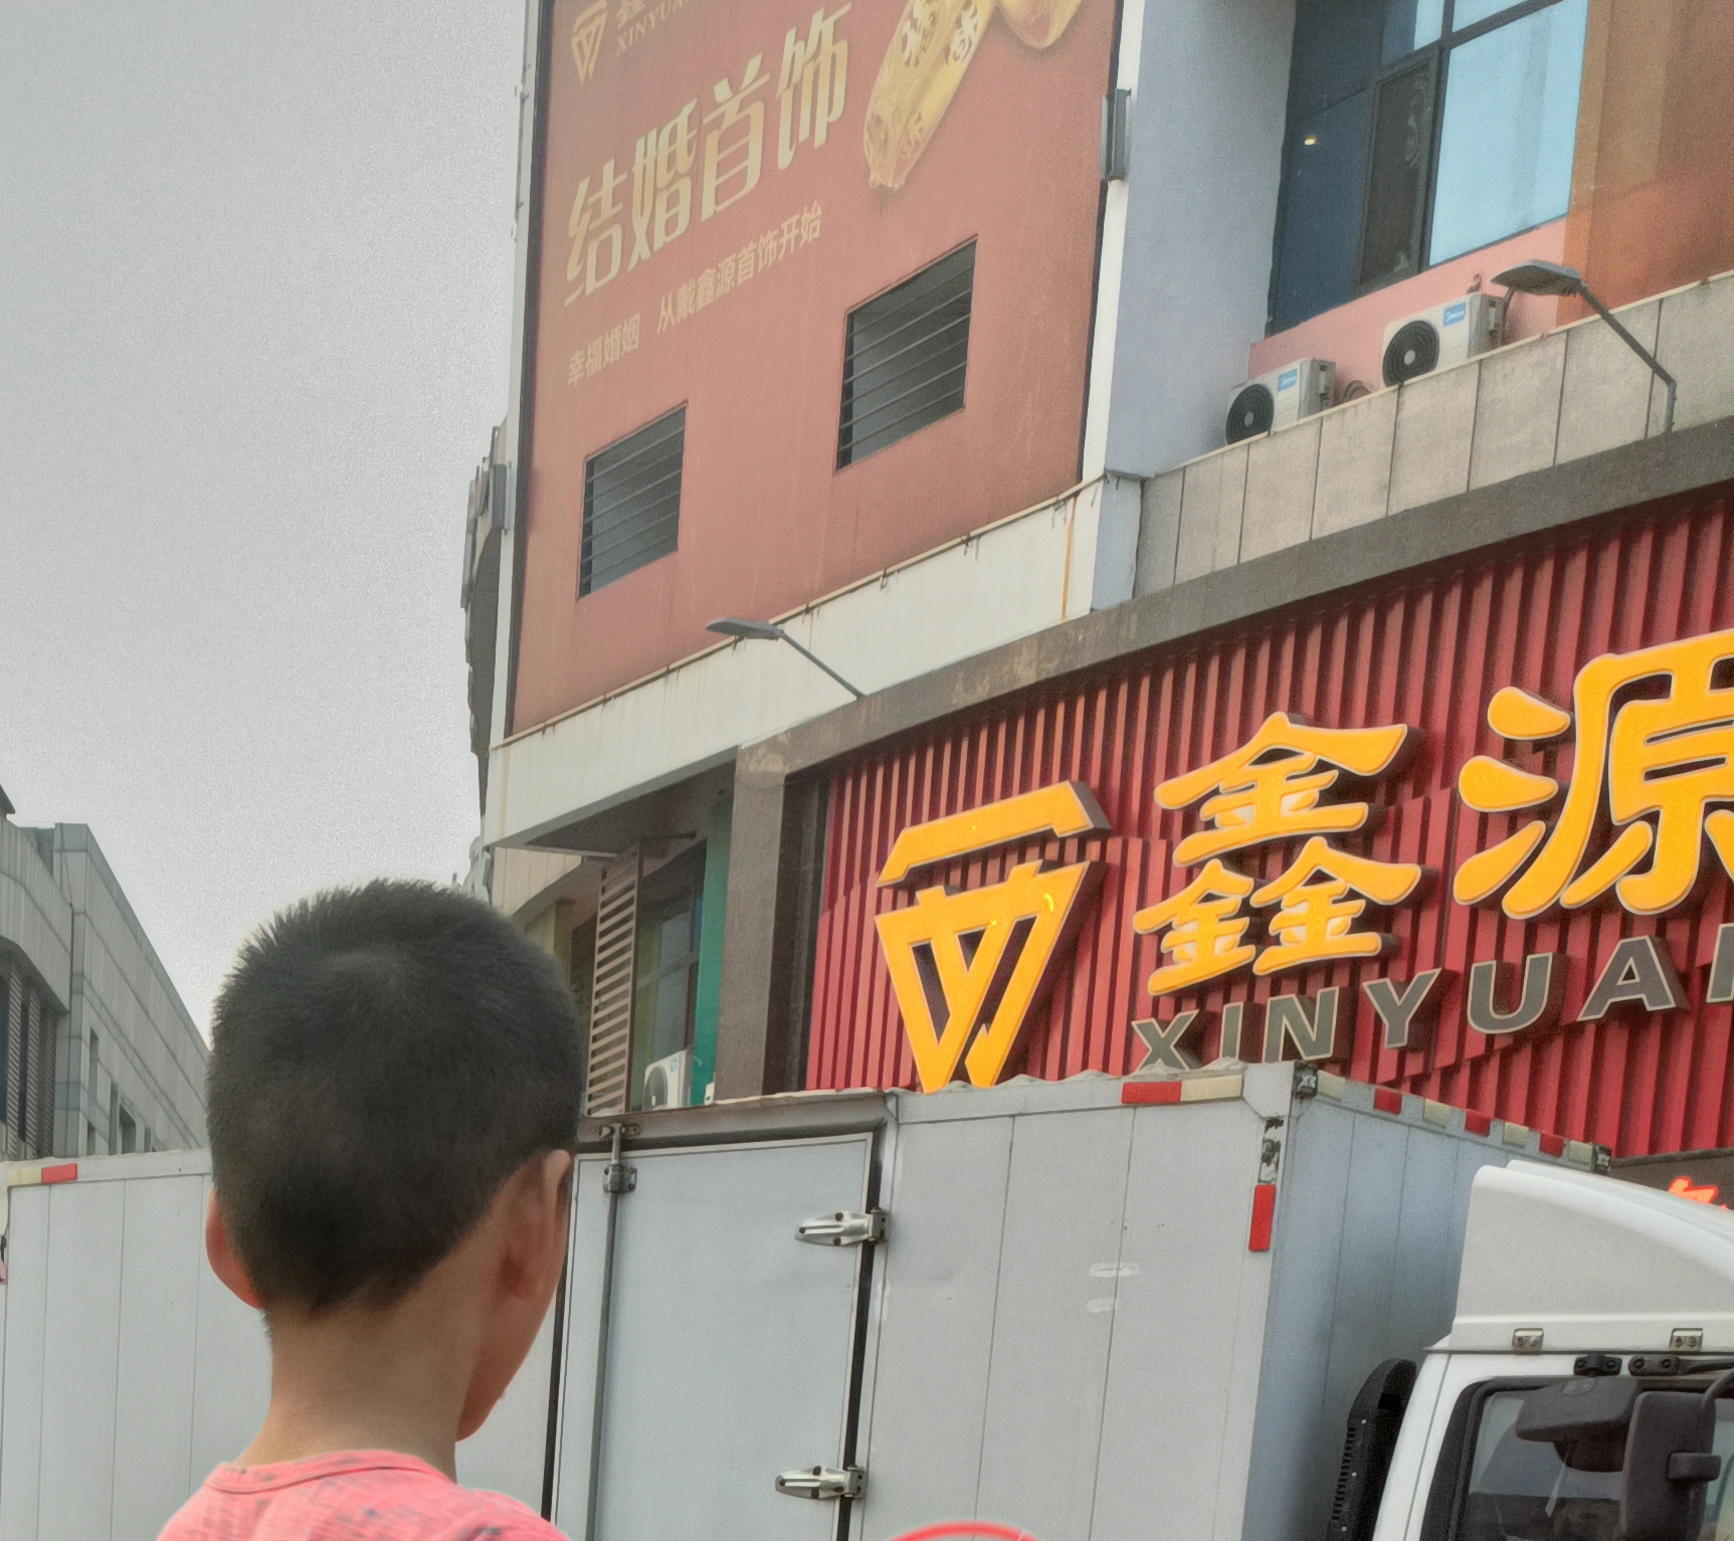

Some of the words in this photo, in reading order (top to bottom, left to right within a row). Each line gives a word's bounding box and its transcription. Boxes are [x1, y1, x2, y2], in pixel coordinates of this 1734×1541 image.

[565, 3, 854, 306] 结婚首饰
[567, 313, 642, 388] 幸福婚姻
[656, 201, 824, 335] 从戴鑫源首饰开始
[1132, 628, 1734, 996] 鑫源
